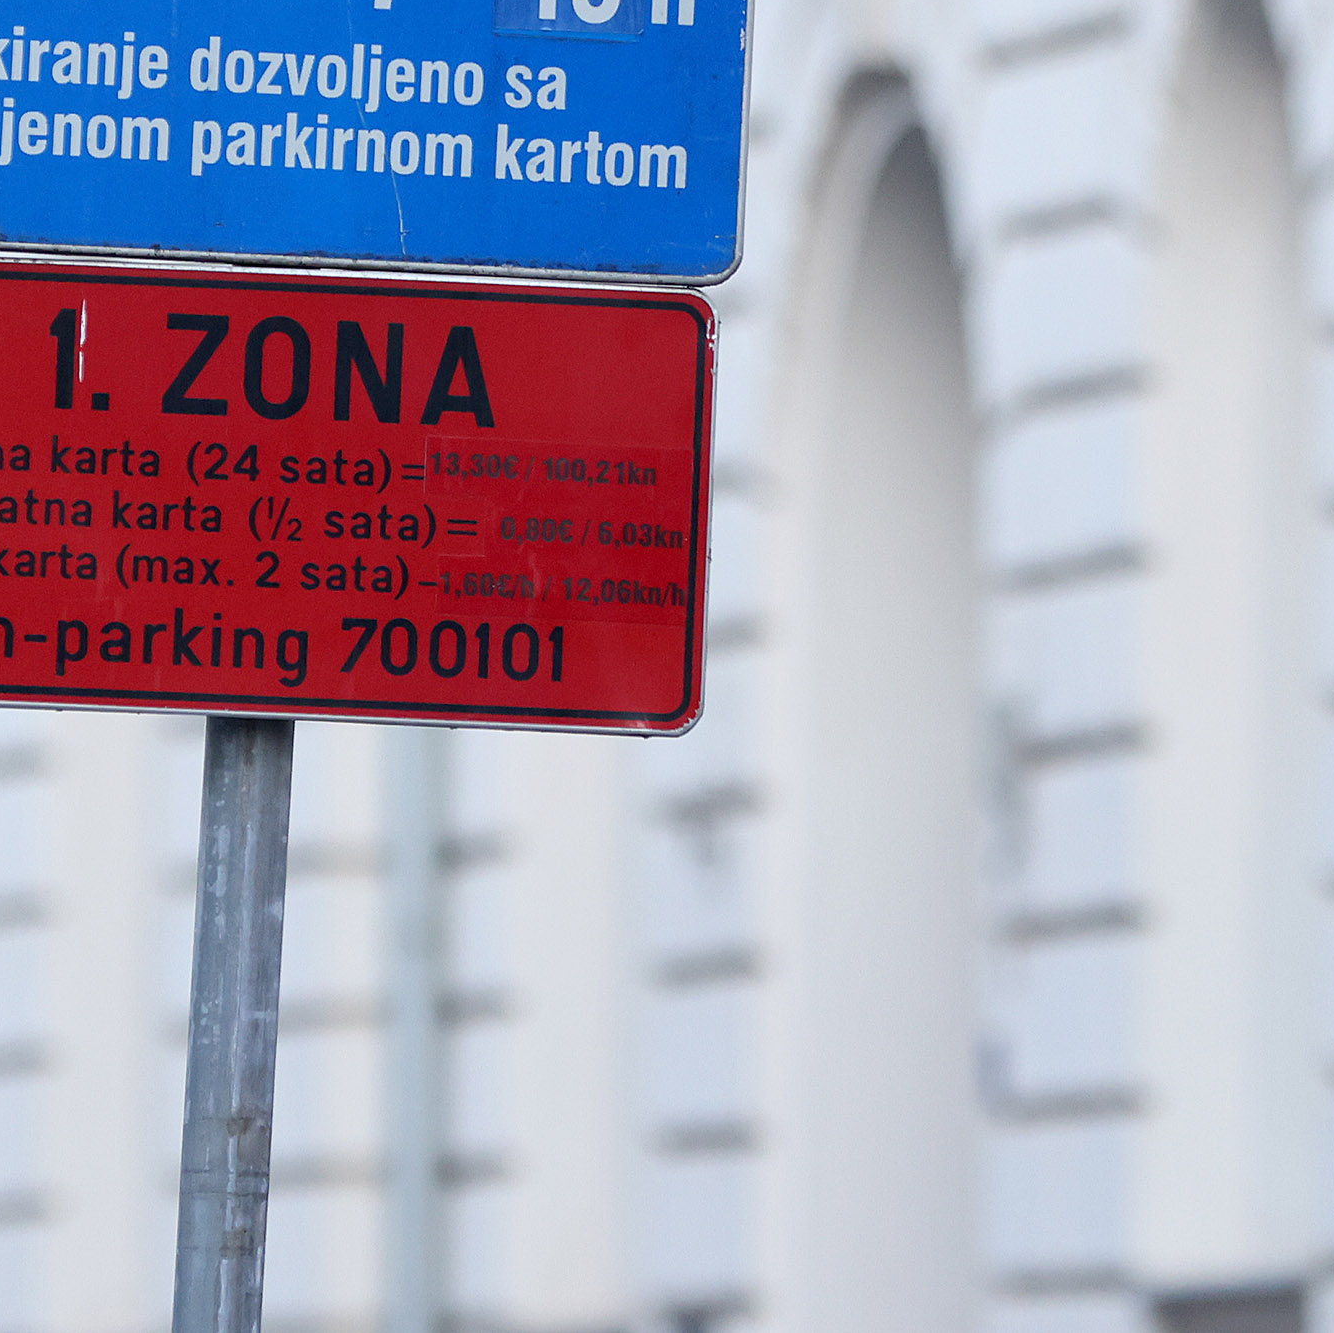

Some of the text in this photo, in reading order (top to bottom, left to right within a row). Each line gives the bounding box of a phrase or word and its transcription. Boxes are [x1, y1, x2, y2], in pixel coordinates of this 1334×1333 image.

[190, 36, 484, 113] dozvoljeno
[504, 64, 567, 110] sa
[191, 112, 473, 178] parkirnom
[495, 123, 688, 189] kartom
[49, 307, 496, 429] 1. ZONA
[50, 434, 161, 478] karta
[186, 440, 261, 487] (24
[112, 489, 223, 533] karta
[115, 543, 234, 590] (max.
[255, 550, 281, 589] 2
[339, 616, 565, 683] 700101
